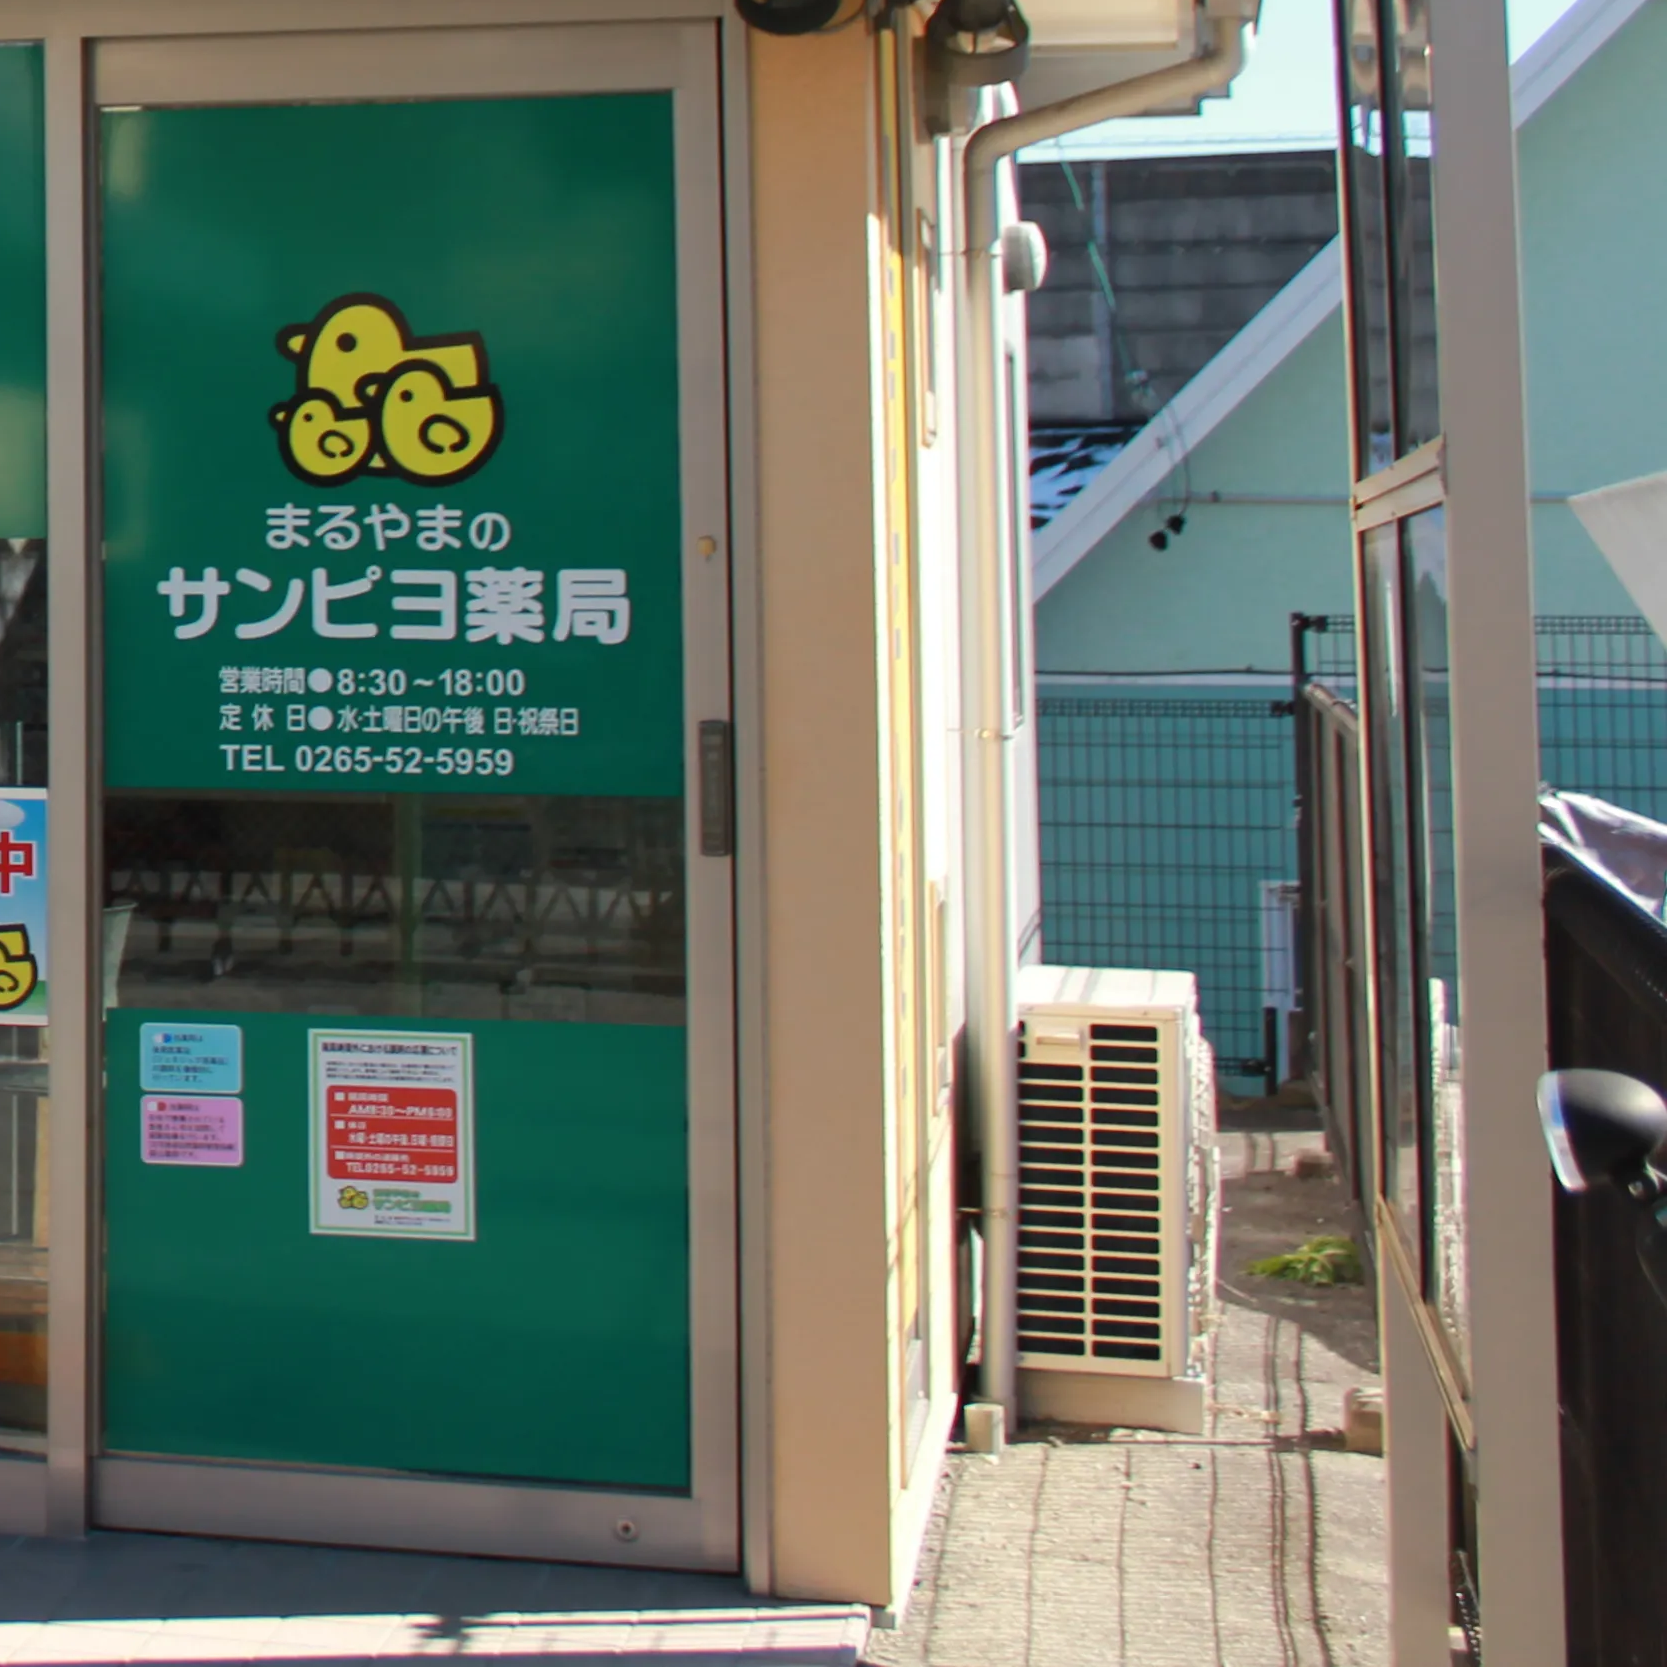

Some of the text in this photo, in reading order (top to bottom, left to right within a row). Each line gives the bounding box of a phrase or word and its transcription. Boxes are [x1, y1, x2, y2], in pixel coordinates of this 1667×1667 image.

[265, 502, 511, 552] まるやまの
[157, 565, 631, 645] サンピヨ薬局
[220, 744, 514, 775] TEL 0265-52-5959
